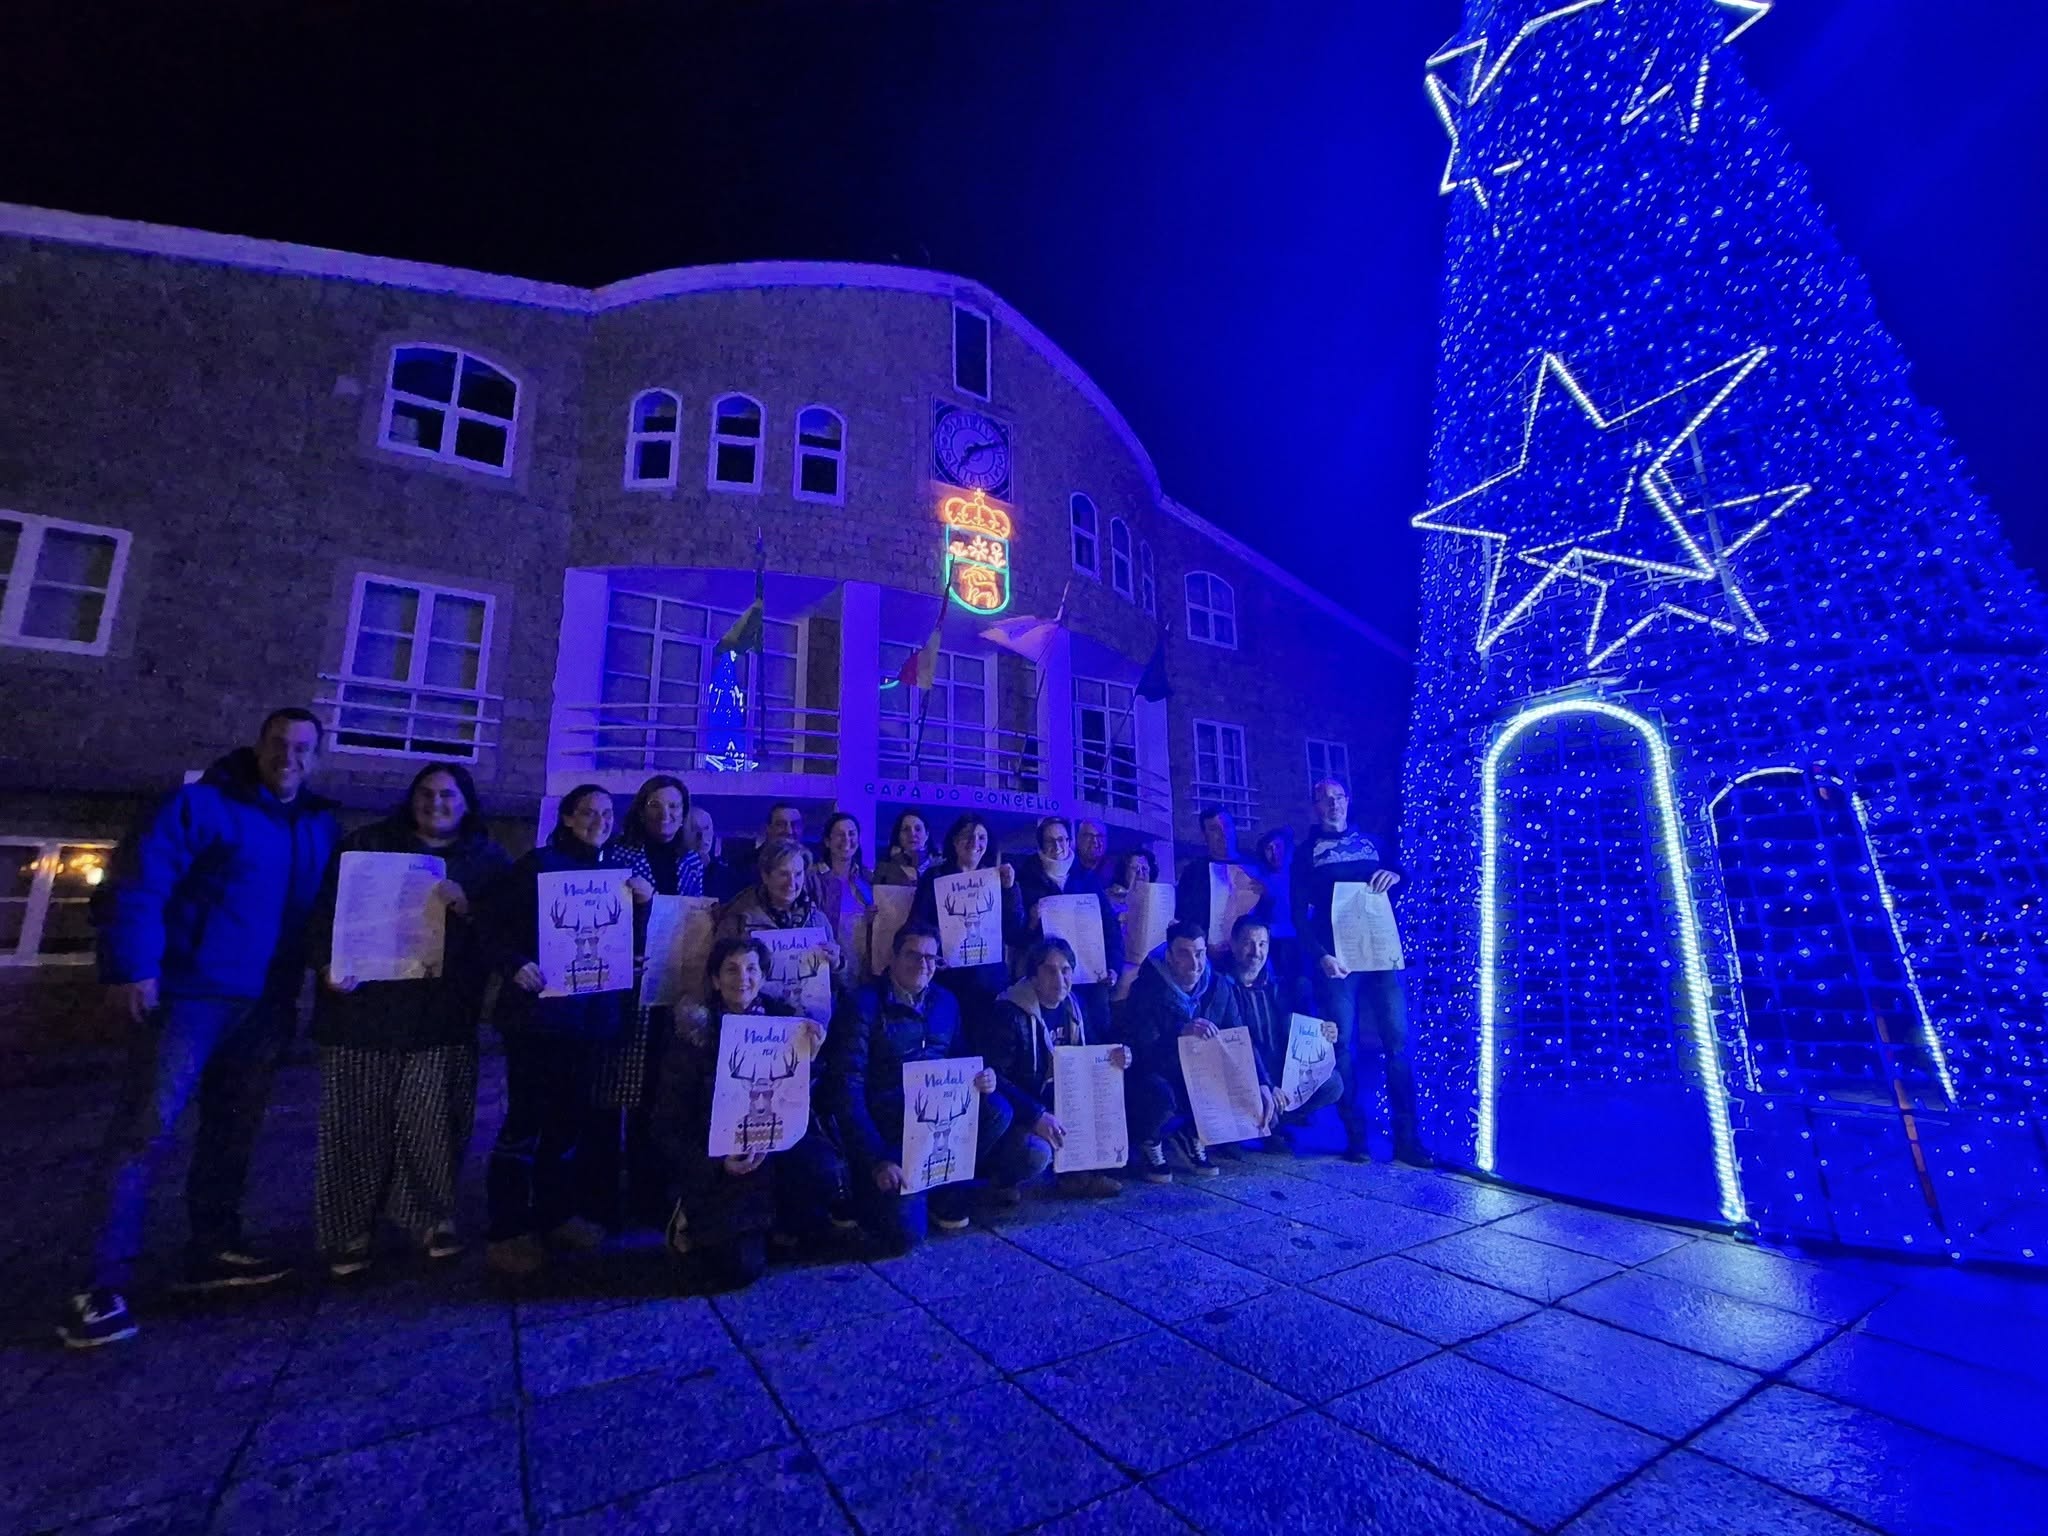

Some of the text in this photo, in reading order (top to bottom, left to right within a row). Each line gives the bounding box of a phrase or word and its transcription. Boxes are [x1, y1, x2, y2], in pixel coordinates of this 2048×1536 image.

[935, 788, 960, 801] DO
[974, 790, 1060, 812] CONCELLO
[564, 880, 609, 896] Nadal
[744, 1026, 788, 1044] Nadal
[925, 1069, 965, 1088] Nadal
